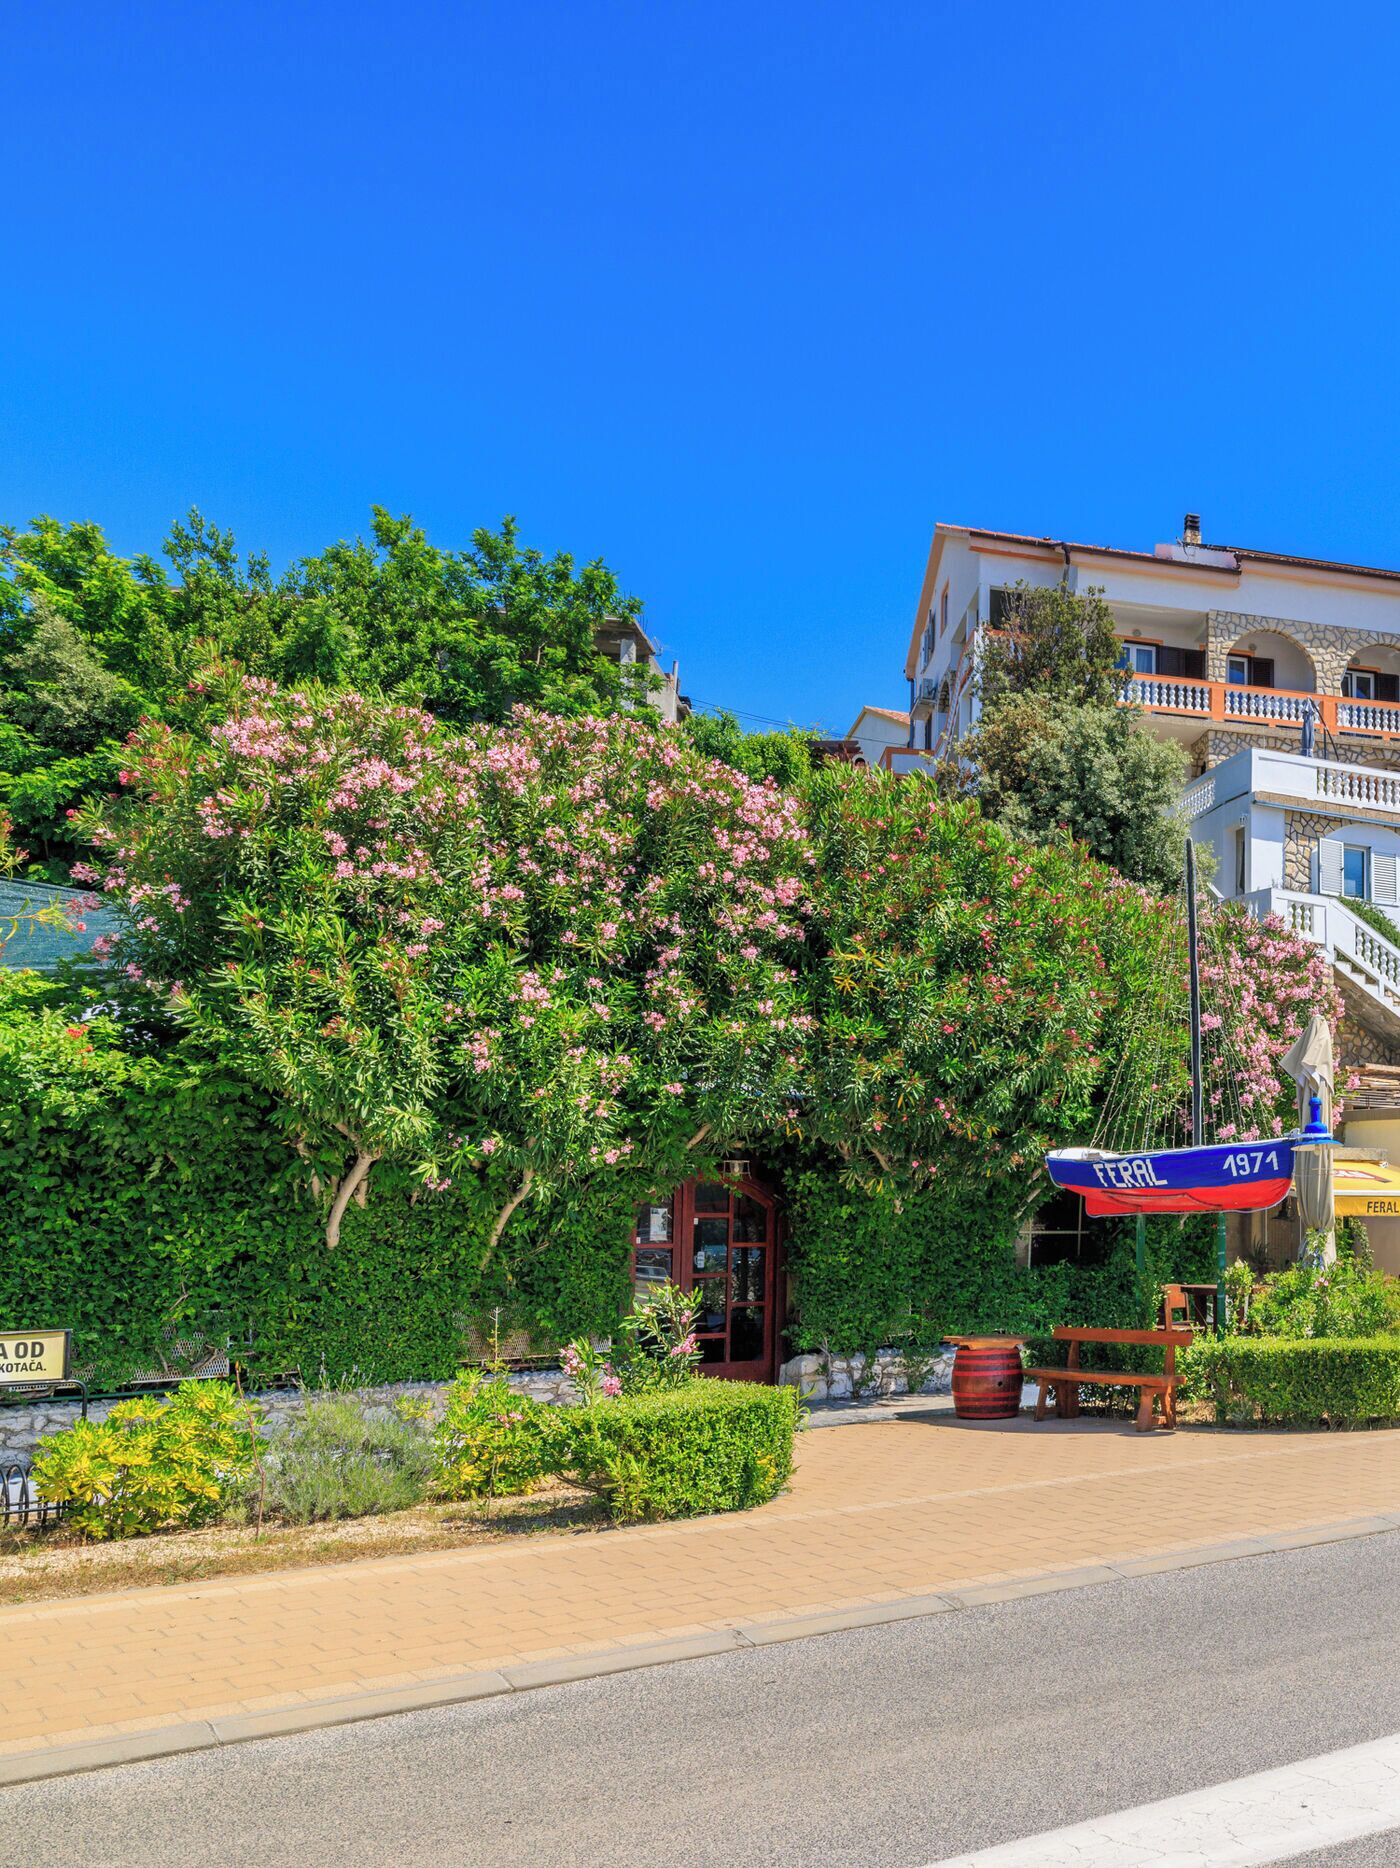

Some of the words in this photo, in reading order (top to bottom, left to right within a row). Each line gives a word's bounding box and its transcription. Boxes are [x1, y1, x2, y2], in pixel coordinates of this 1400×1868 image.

[1092, 1159, 1168, 1188] FERAL
[1222, 1150, 1279, 1177] 1971
[1366, 1201, 1400, 1213] FERAL
[14, 1341, 45, 1360] OD
